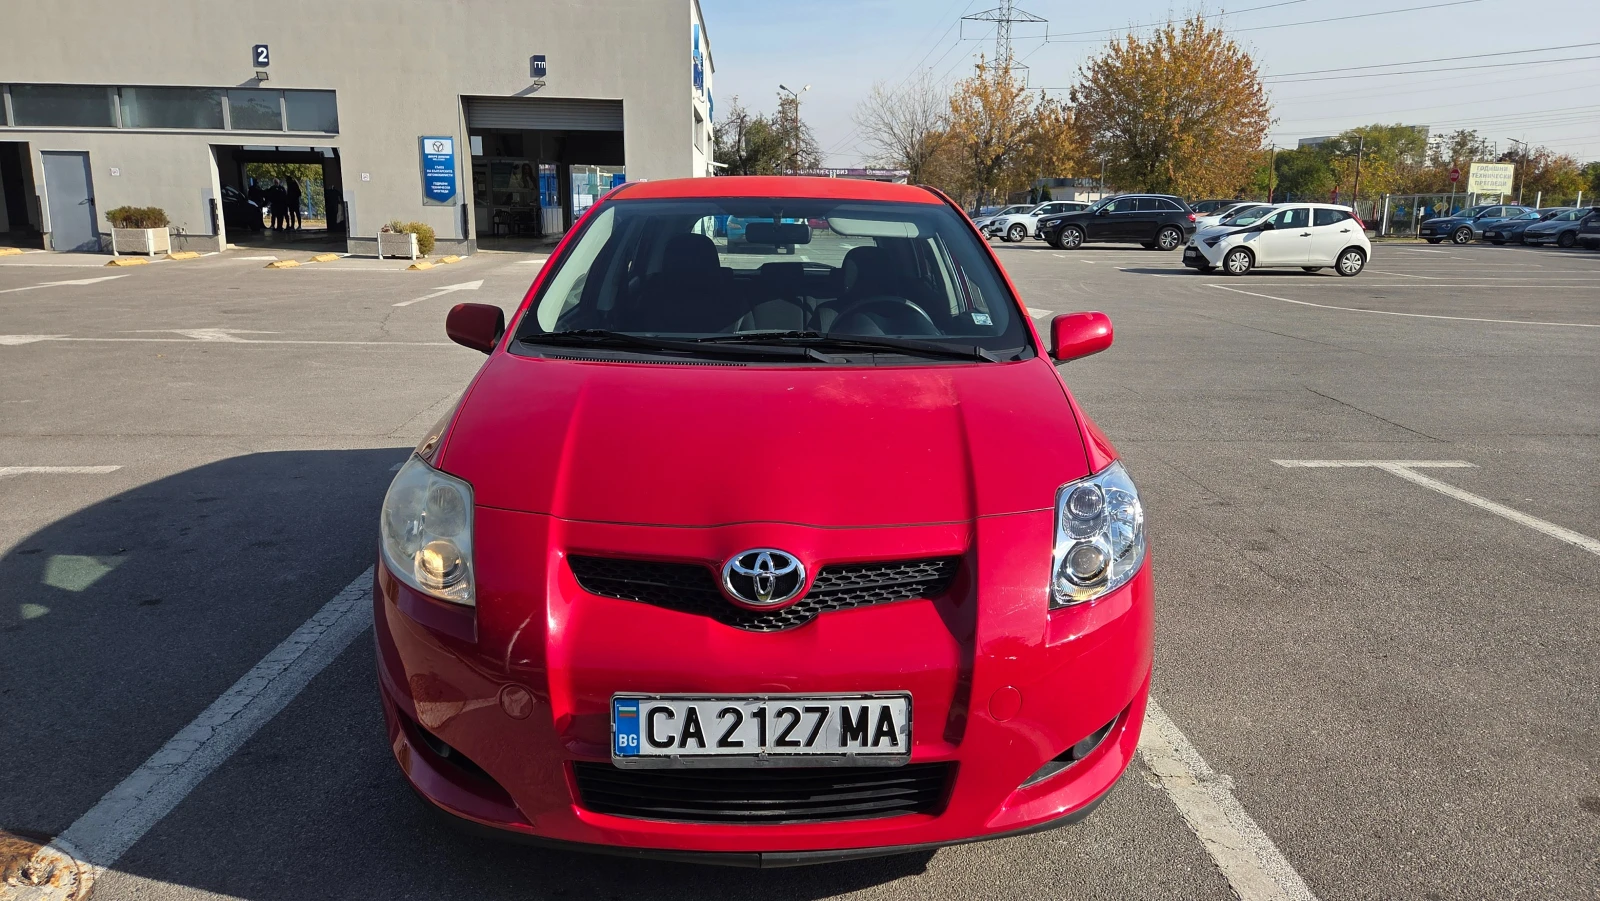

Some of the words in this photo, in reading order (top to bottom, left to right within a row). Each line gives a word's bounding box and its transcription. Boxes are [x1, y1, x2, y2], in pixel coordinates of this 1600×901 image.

[258, 47, 268, 62] 2
[1471, 172, 1512, 180] ТЕХНИЧЕСКИ
[619, 733, 638, 747] BG
[646, 706, 706, 748] CA
[716, 706, 830, 748] 2127
[840, 706, 900, 748] MA
